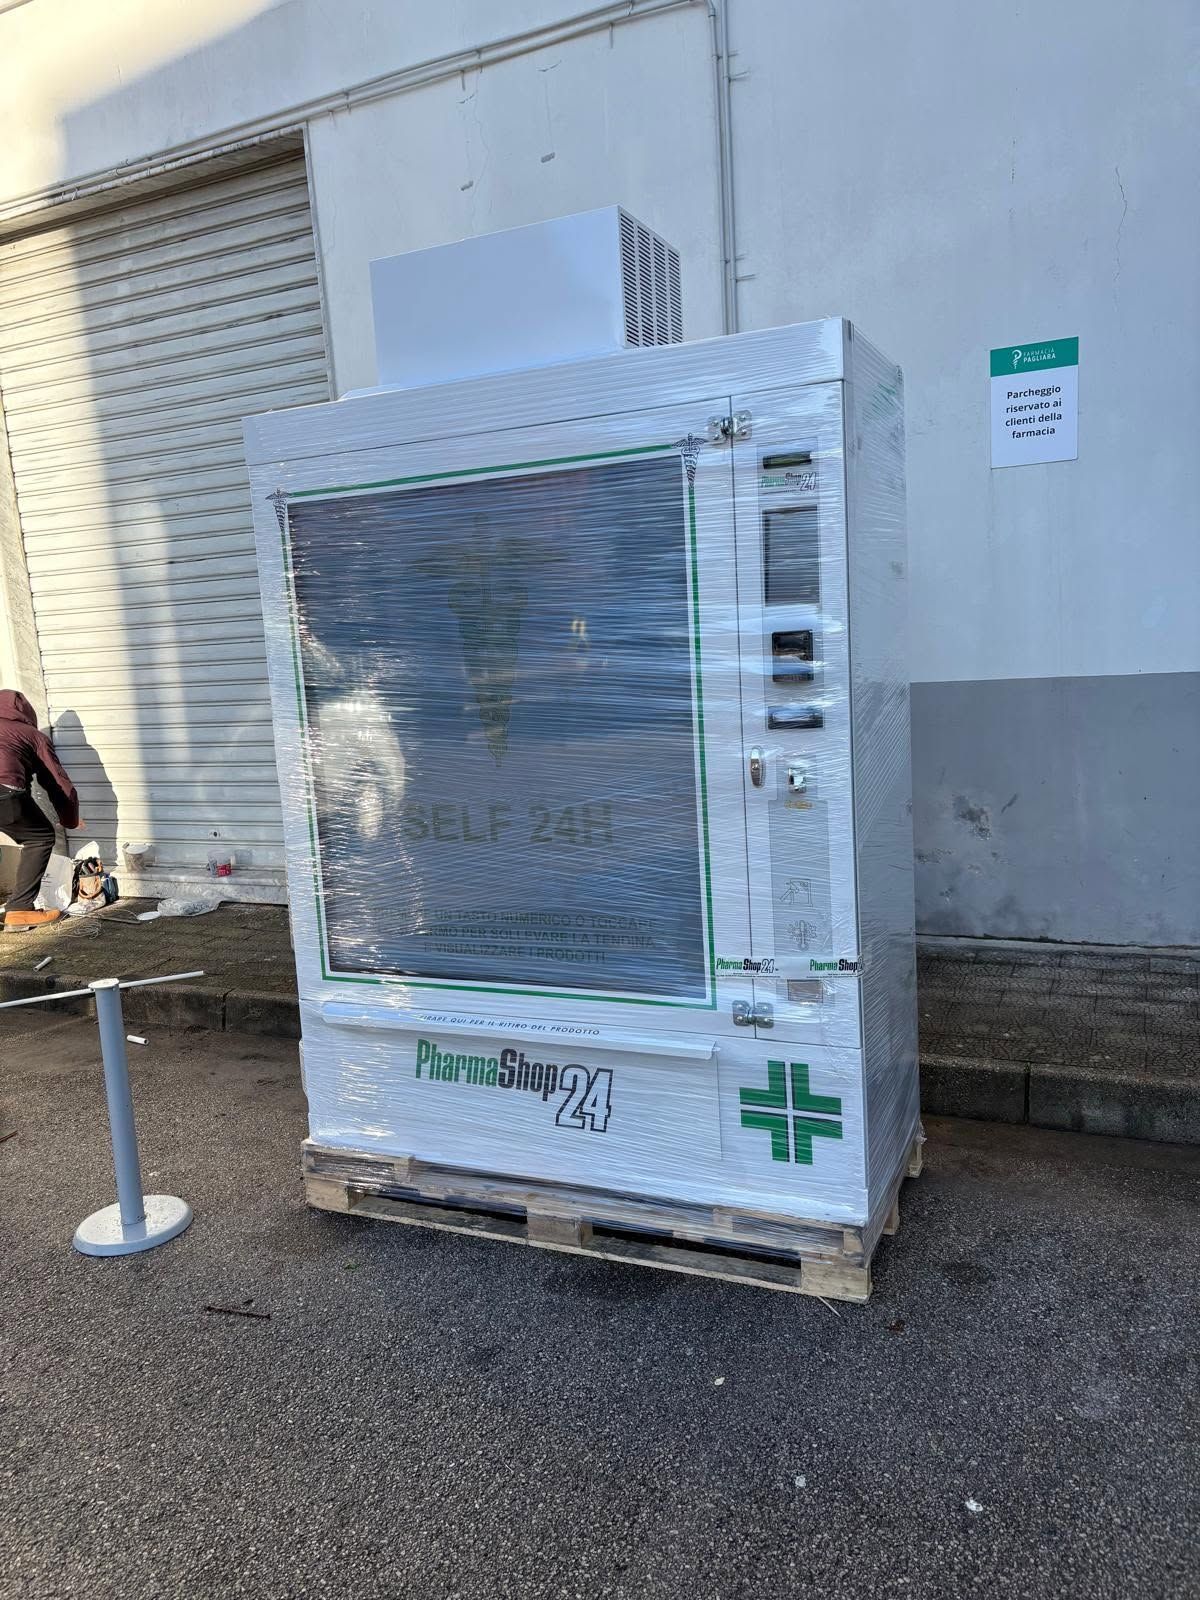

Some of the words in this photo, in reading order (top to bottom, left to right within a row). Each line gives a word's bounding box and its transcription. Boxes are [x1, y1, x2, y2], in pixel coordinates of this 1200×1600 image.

[1023, 347, 1055, 356] FARMACIA
[1023, 353, 1056, 363] PAGLIARA
[1007, 385, 1061, 400] Parcheggio
[1006, 402, 1050, 413] riservato
[1053, 398, 1062, 408] ai
[1005, 415, 1036, 427] clienti
[1038, 412, 1062, 423] della
[1012, 426, 1056, 439] farmacia
[402, 803, 512, 843] SELF
[528, 802, 615, 844] 24H
[715, 957, 775, 974] PharmaShop24
[550, 1026, 600, 1036] PRODOTTO
[415, 1037, 614, 1133] PharmaShop24
